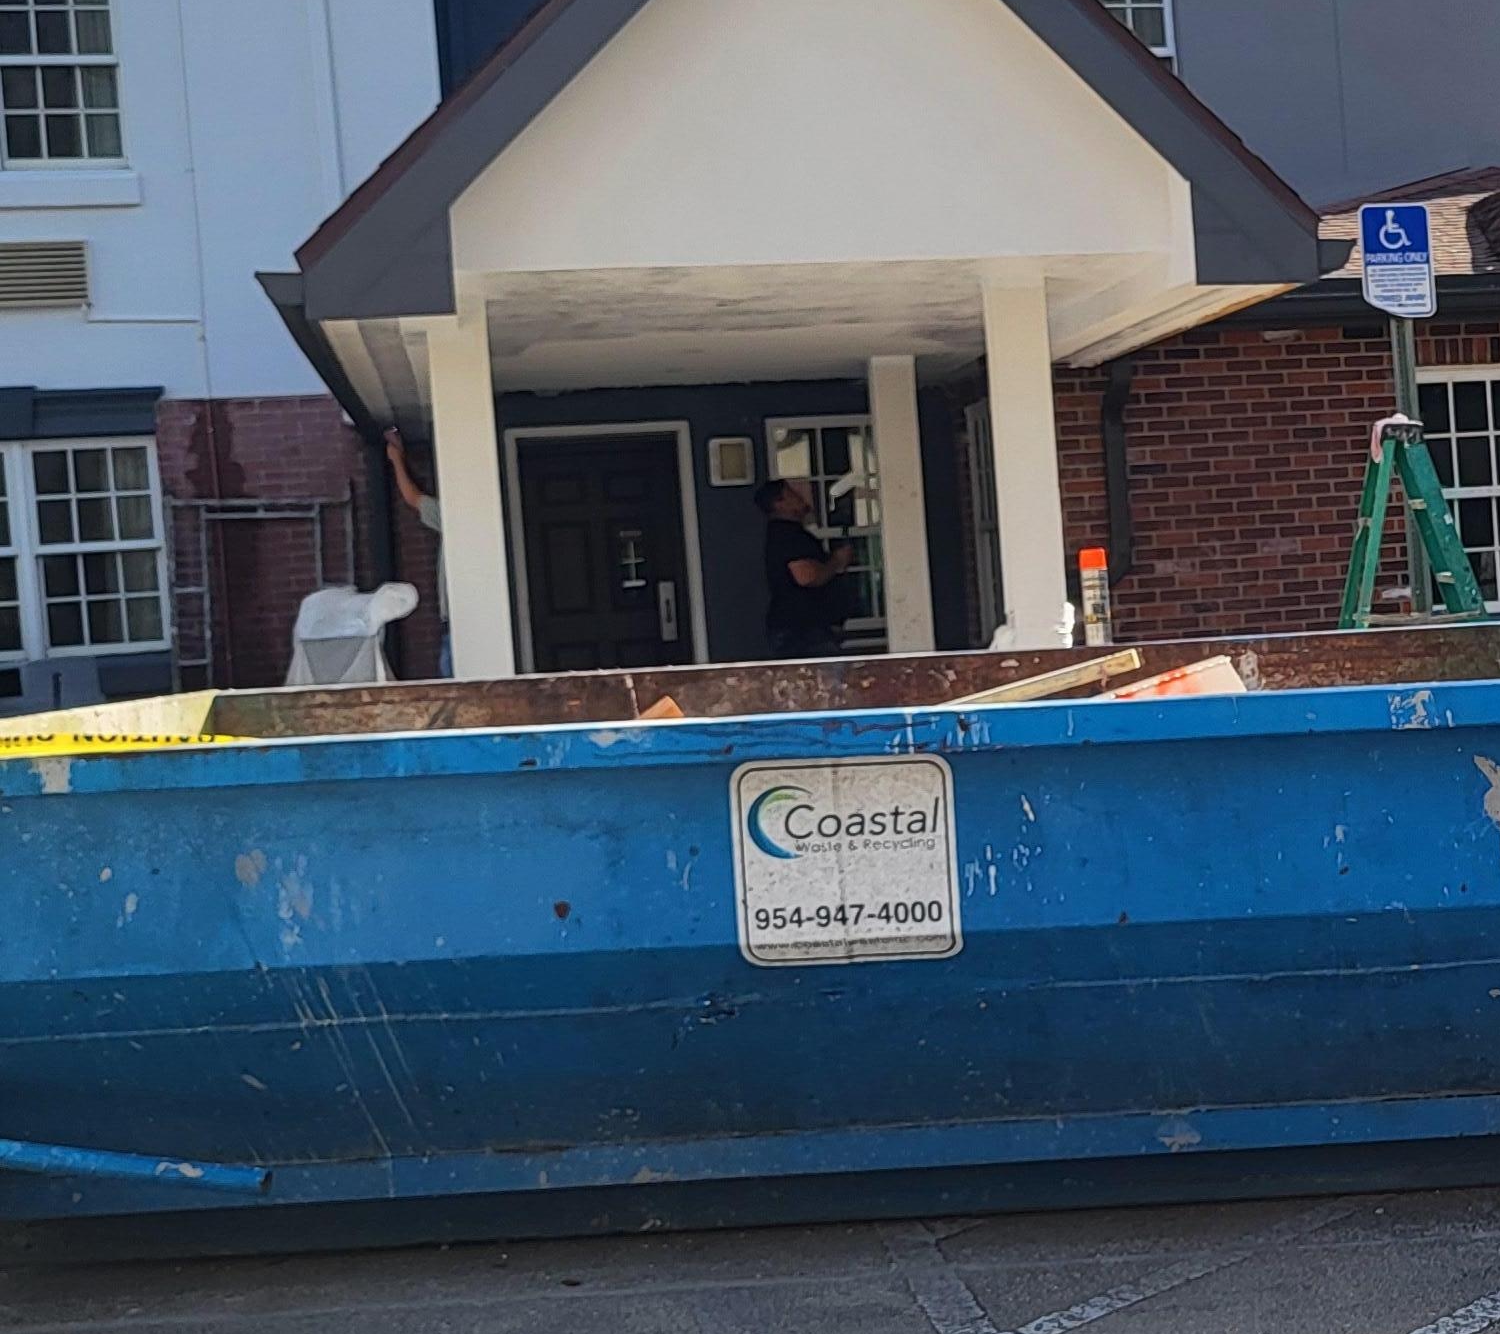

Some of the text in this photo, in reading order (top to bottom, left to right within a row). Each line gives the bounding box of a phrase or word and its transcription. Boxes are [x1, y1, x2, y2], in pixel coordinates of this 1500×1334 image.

[1365, 251, 1427, 264] PARKING ONLY
[784, 796, 940, 840] Coastal
[794, 837, 936, 854] Waste & Recycling
[754, 900, 943, 931] 954-947-4000
